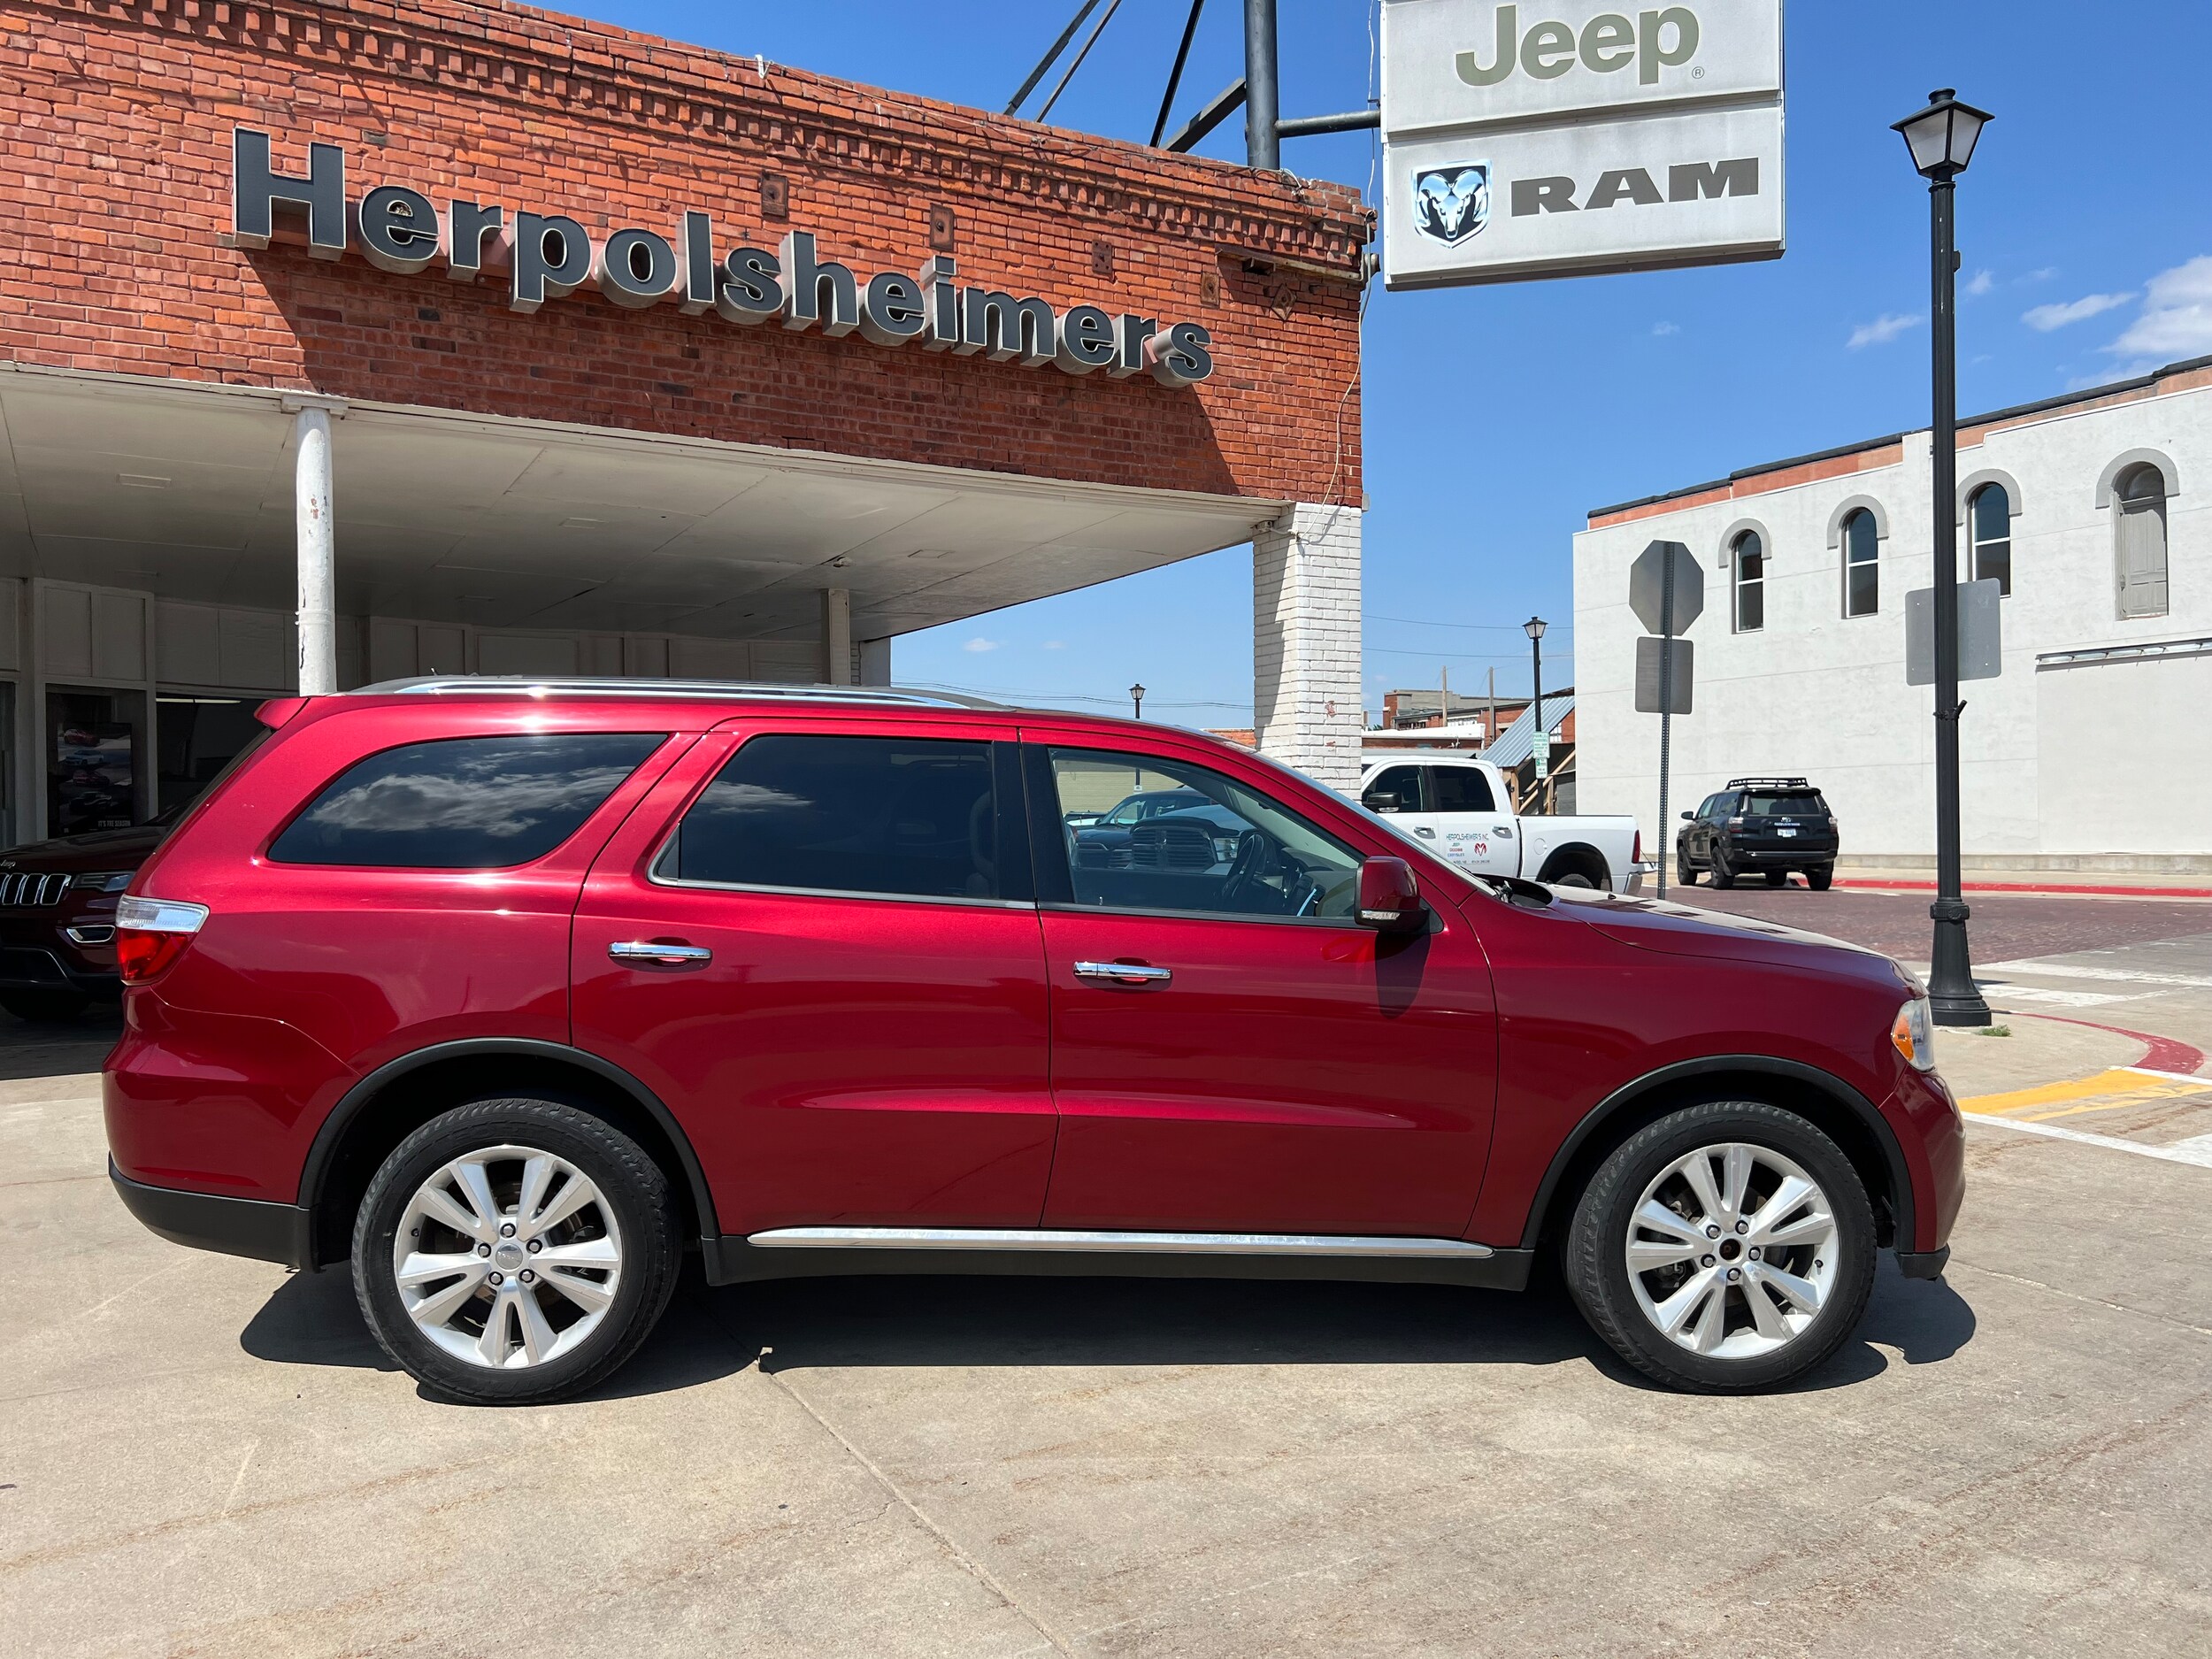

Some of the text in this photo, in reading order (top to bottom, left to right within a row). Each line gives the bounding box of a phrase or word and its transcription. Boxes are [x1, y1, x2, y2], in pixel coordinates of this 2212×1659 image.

[1455, 5, 1699, 86] Jeep
[1510, 157, 1759, 217] RAM
[233, 127, 1213, 384] Herpolsheimers
